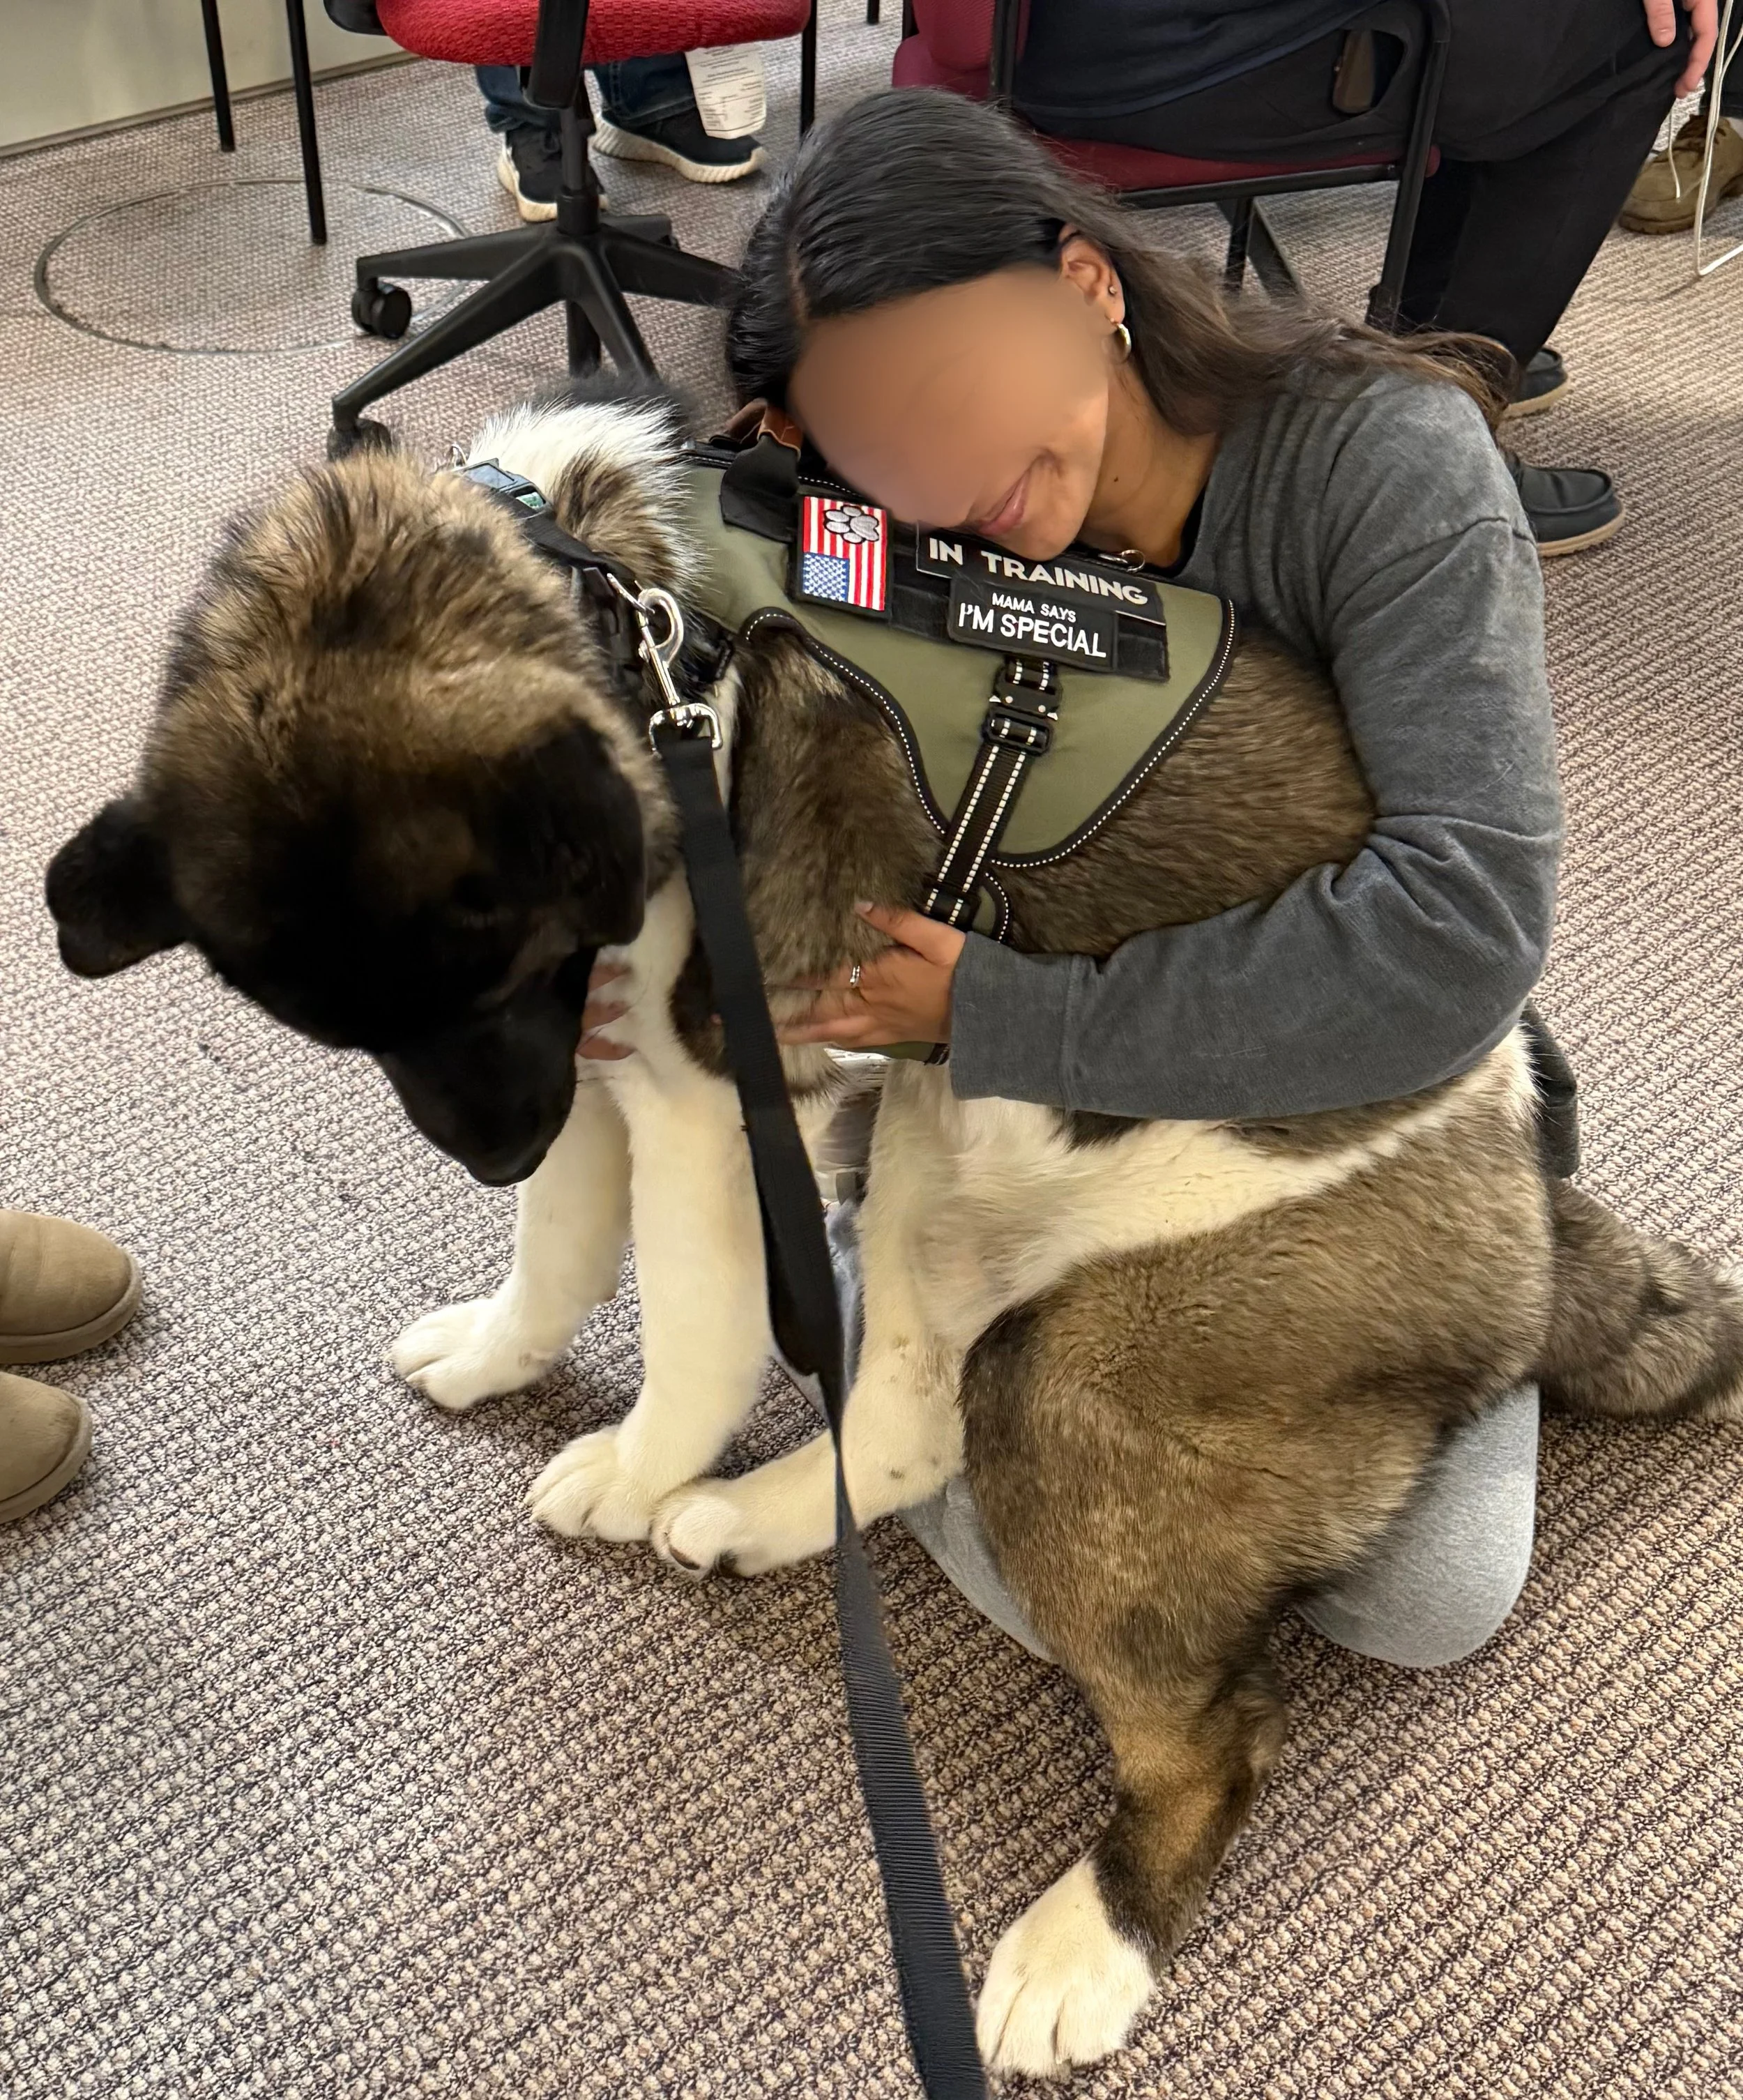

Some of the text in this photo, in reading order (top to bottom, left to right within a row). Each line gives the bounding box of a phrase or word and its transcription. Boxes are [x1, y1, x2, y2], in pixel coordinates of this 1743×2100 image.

[929, 538, 1148, 604] IN TRAINING
[959, 602, 1107, 657] I'M SPECIAL
[991, 593, 1076, 623] MAMA SAYS
